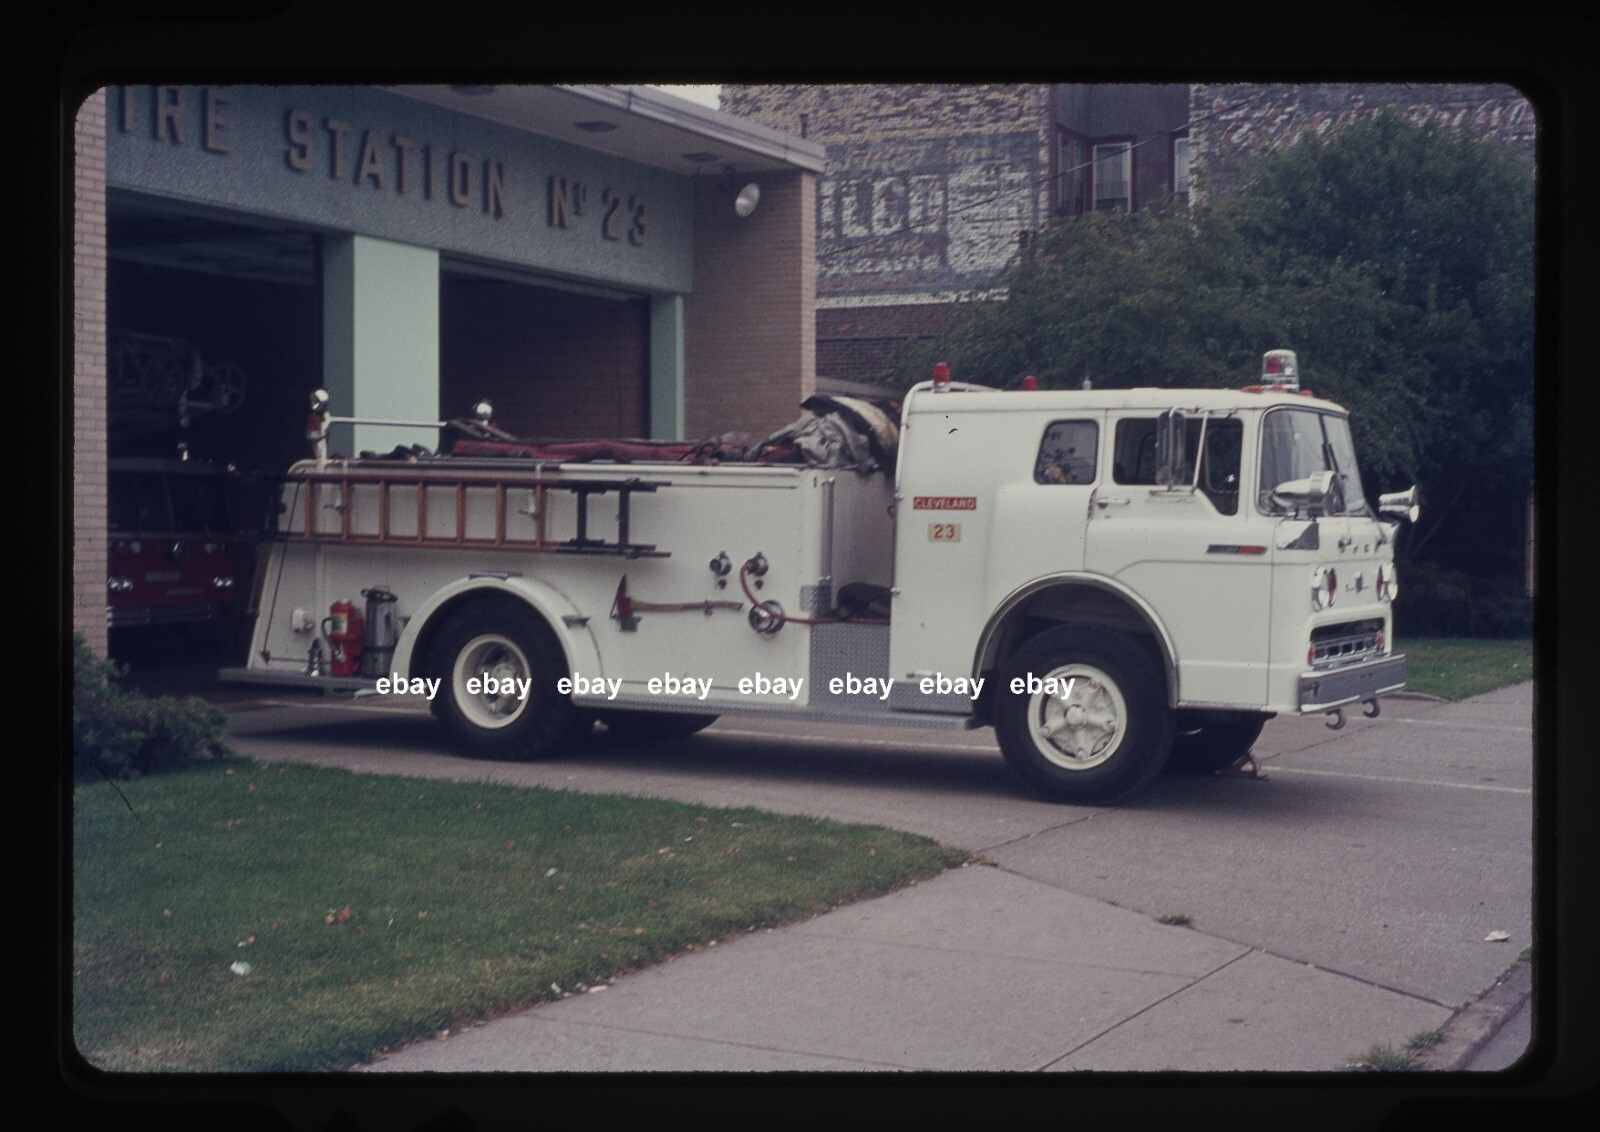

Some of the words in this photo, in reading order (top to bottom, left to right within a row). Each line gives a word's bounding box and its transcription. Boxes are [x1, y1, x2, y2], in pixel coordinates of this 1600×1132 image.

[284, 107, 509, 220] STATION
[602, 187, 649, 247] 23
[914, 497, 975, 509] CLEVELAND
[933, 523, 955, 539] 23
